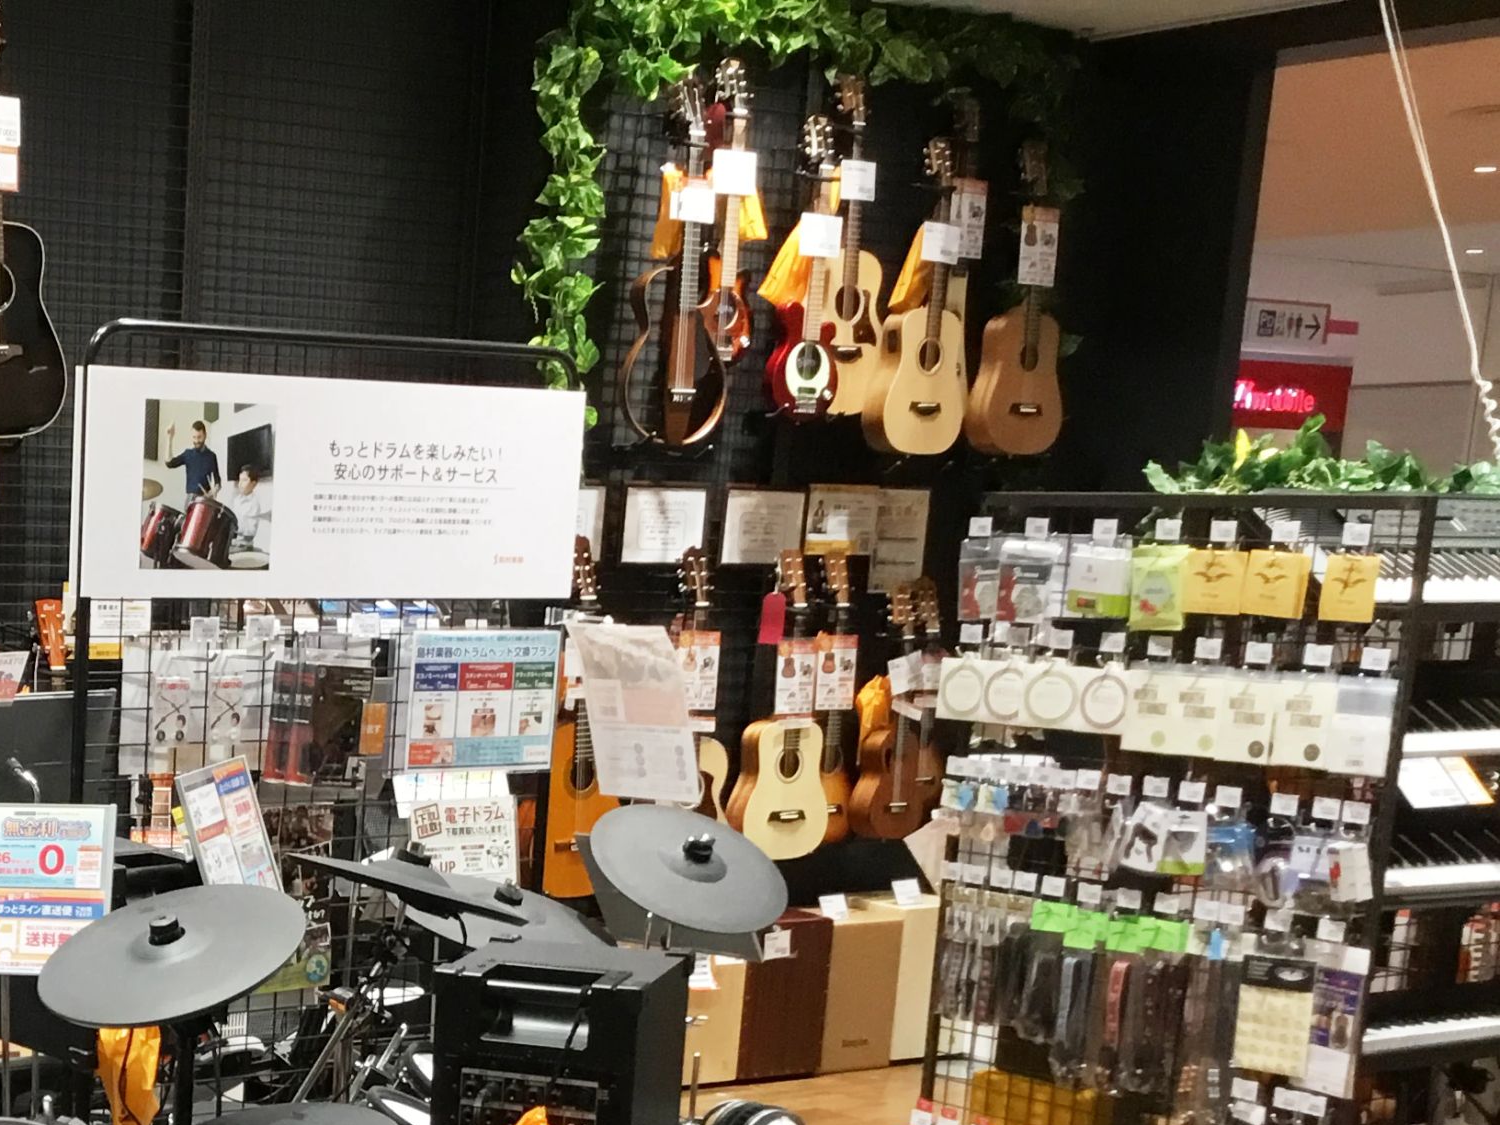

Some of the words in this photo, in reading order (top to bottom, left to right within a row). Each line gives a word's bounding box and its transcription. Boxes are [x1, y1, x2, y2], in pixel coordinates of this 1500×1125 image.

[329, 439, 503, 462] もっとドラムを楽しみたい！
[333, 463, 499, 484] 安心のサポート＆サービス
[445, 805, 505, 824] 電子ドラム
